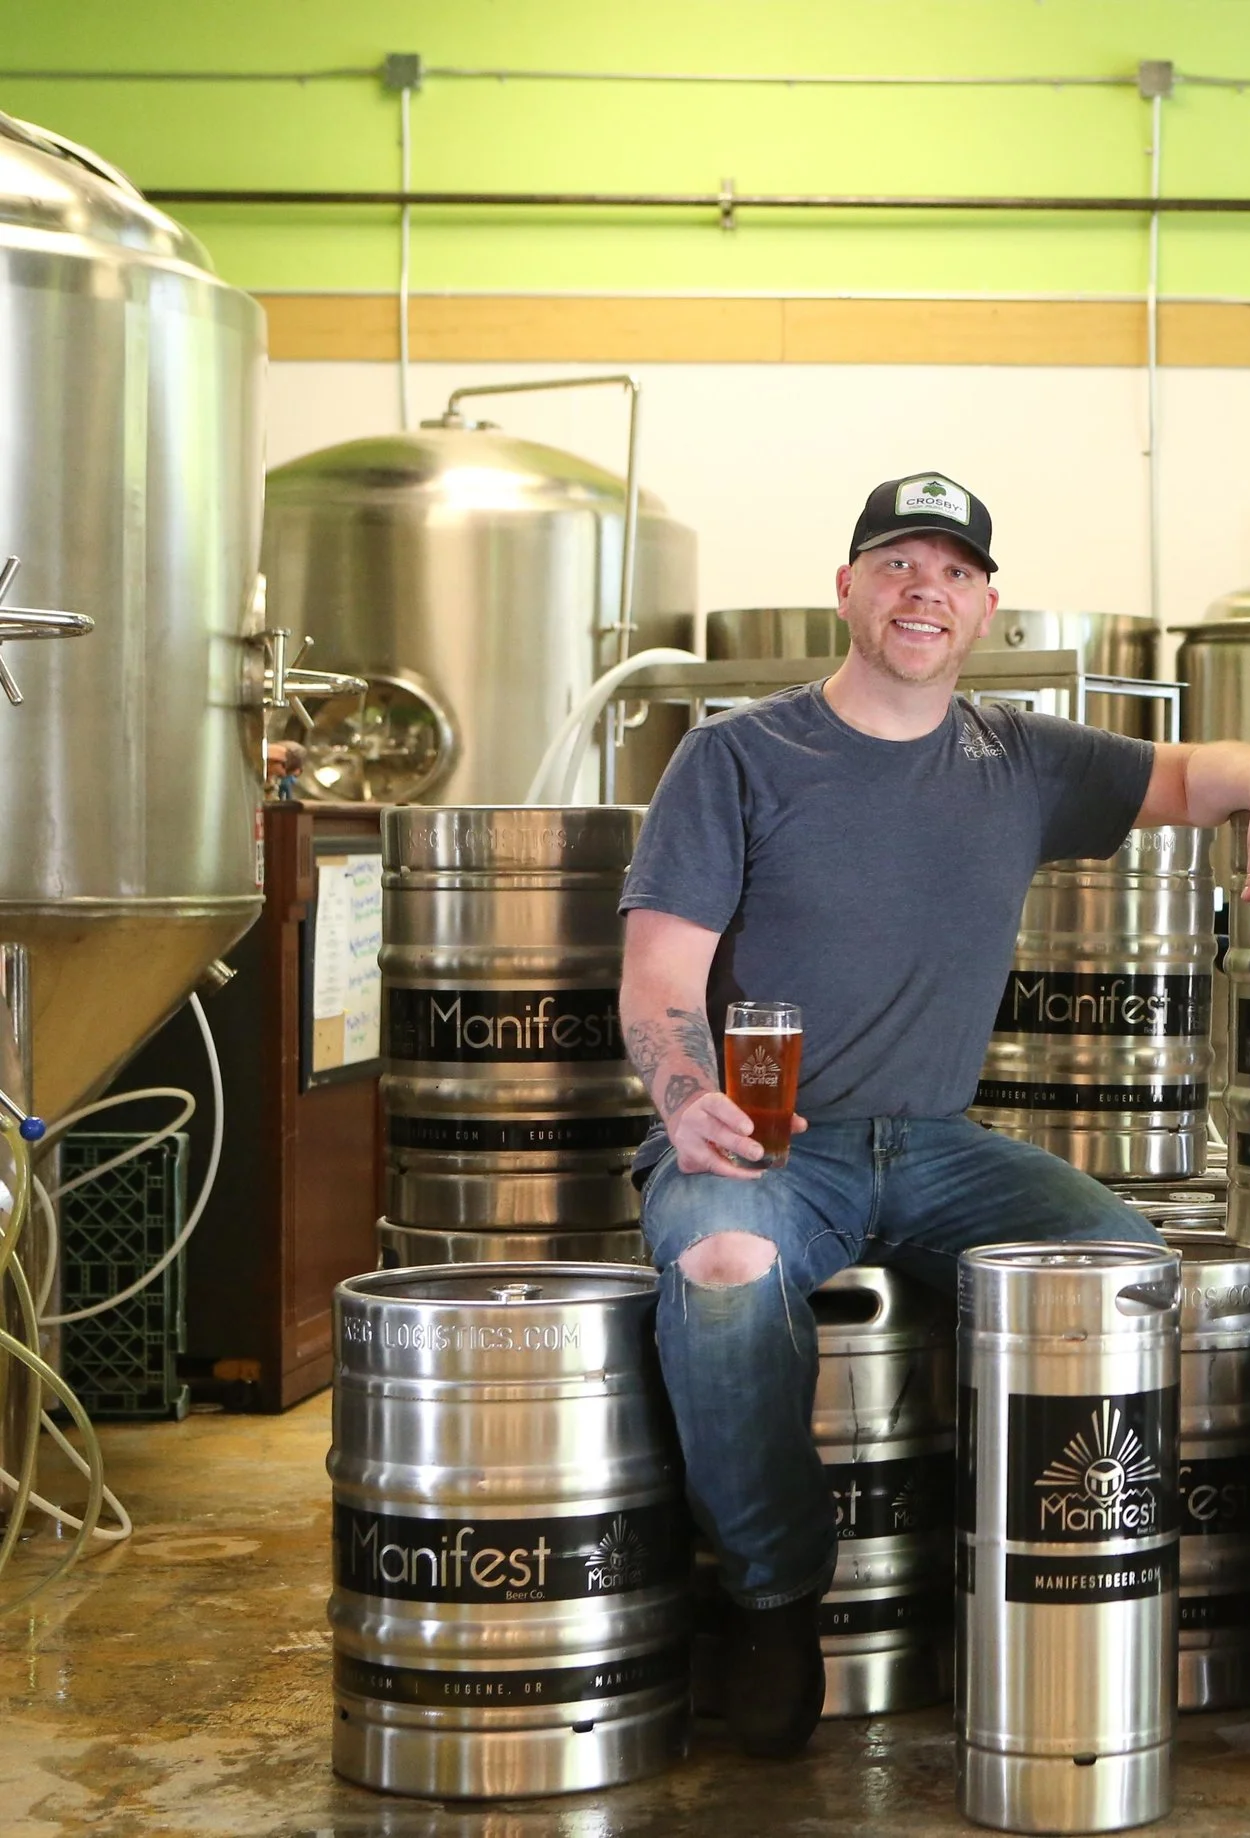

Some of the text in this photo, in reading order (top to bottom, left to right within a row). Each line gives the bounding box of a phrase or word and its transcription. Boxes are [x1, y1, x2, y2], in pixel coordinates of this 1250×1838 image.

[906, 497, 960, 511] CROSBY
[1013, 977, 1171, 1025] Manifest
[429, 996, 617, 1049] Manifest
[344, 1315, 582, 1351] KEG LOGISTICS.COM
[1041, 1496, 1157, 1531] Manifest
[351, 1516, 552, 1588] Manifest
[1035, 1565, 1161, 1589] MANIFESTBEER.COM
[505, 1589, 546, 1601] Beer Co.
[525, 1682, 543, 1693] OR
